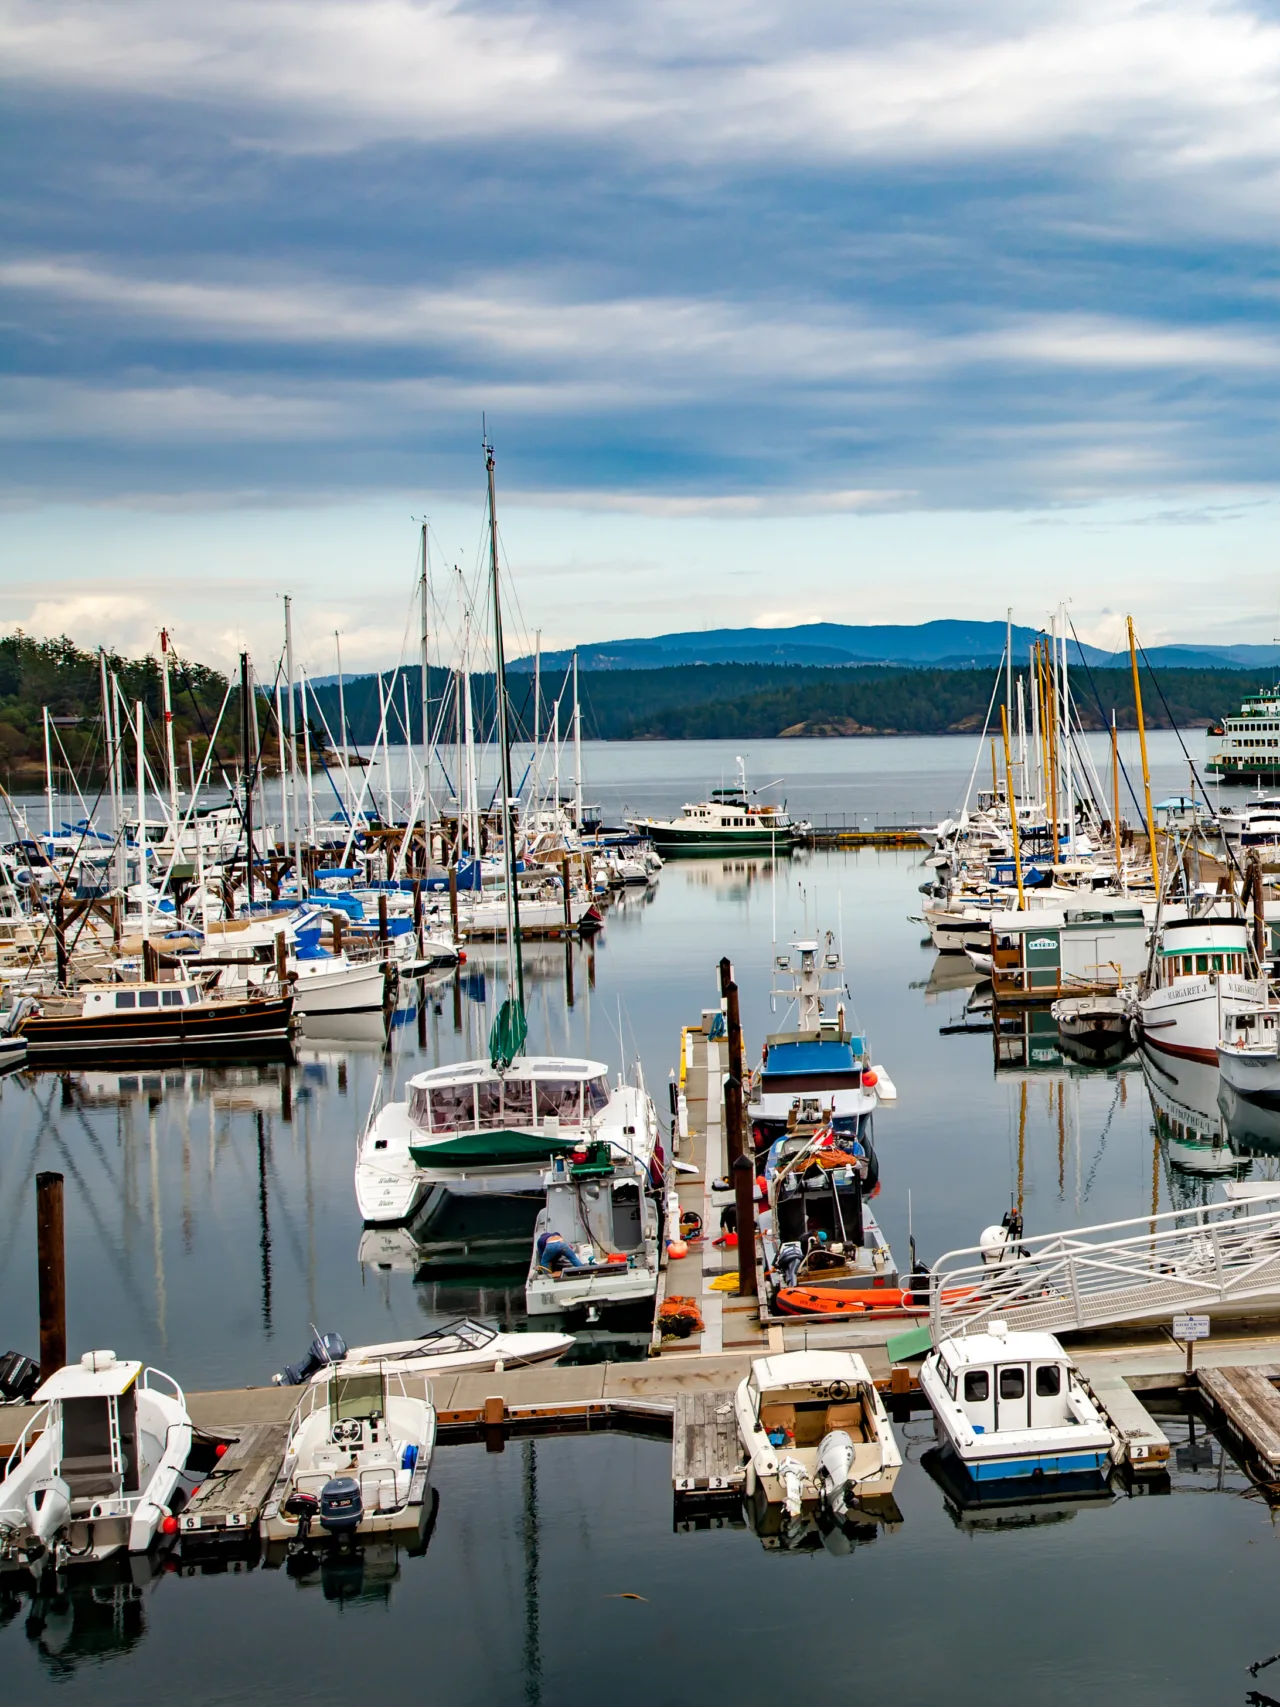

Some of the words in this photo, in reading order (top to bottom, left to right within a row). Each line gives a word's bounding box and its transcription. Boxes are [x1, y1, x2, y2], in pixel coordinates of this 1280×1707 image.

[1167, 985, 1200, 999] MARGARET
[1136, 1447, 1143, 1456] 2
[681, 1479, 688, 1489] 4
[715, 1477, 722, 1487] 3
[186, 1517, 195, 1528] 6
[232, 1514, 240, 1524] 5
